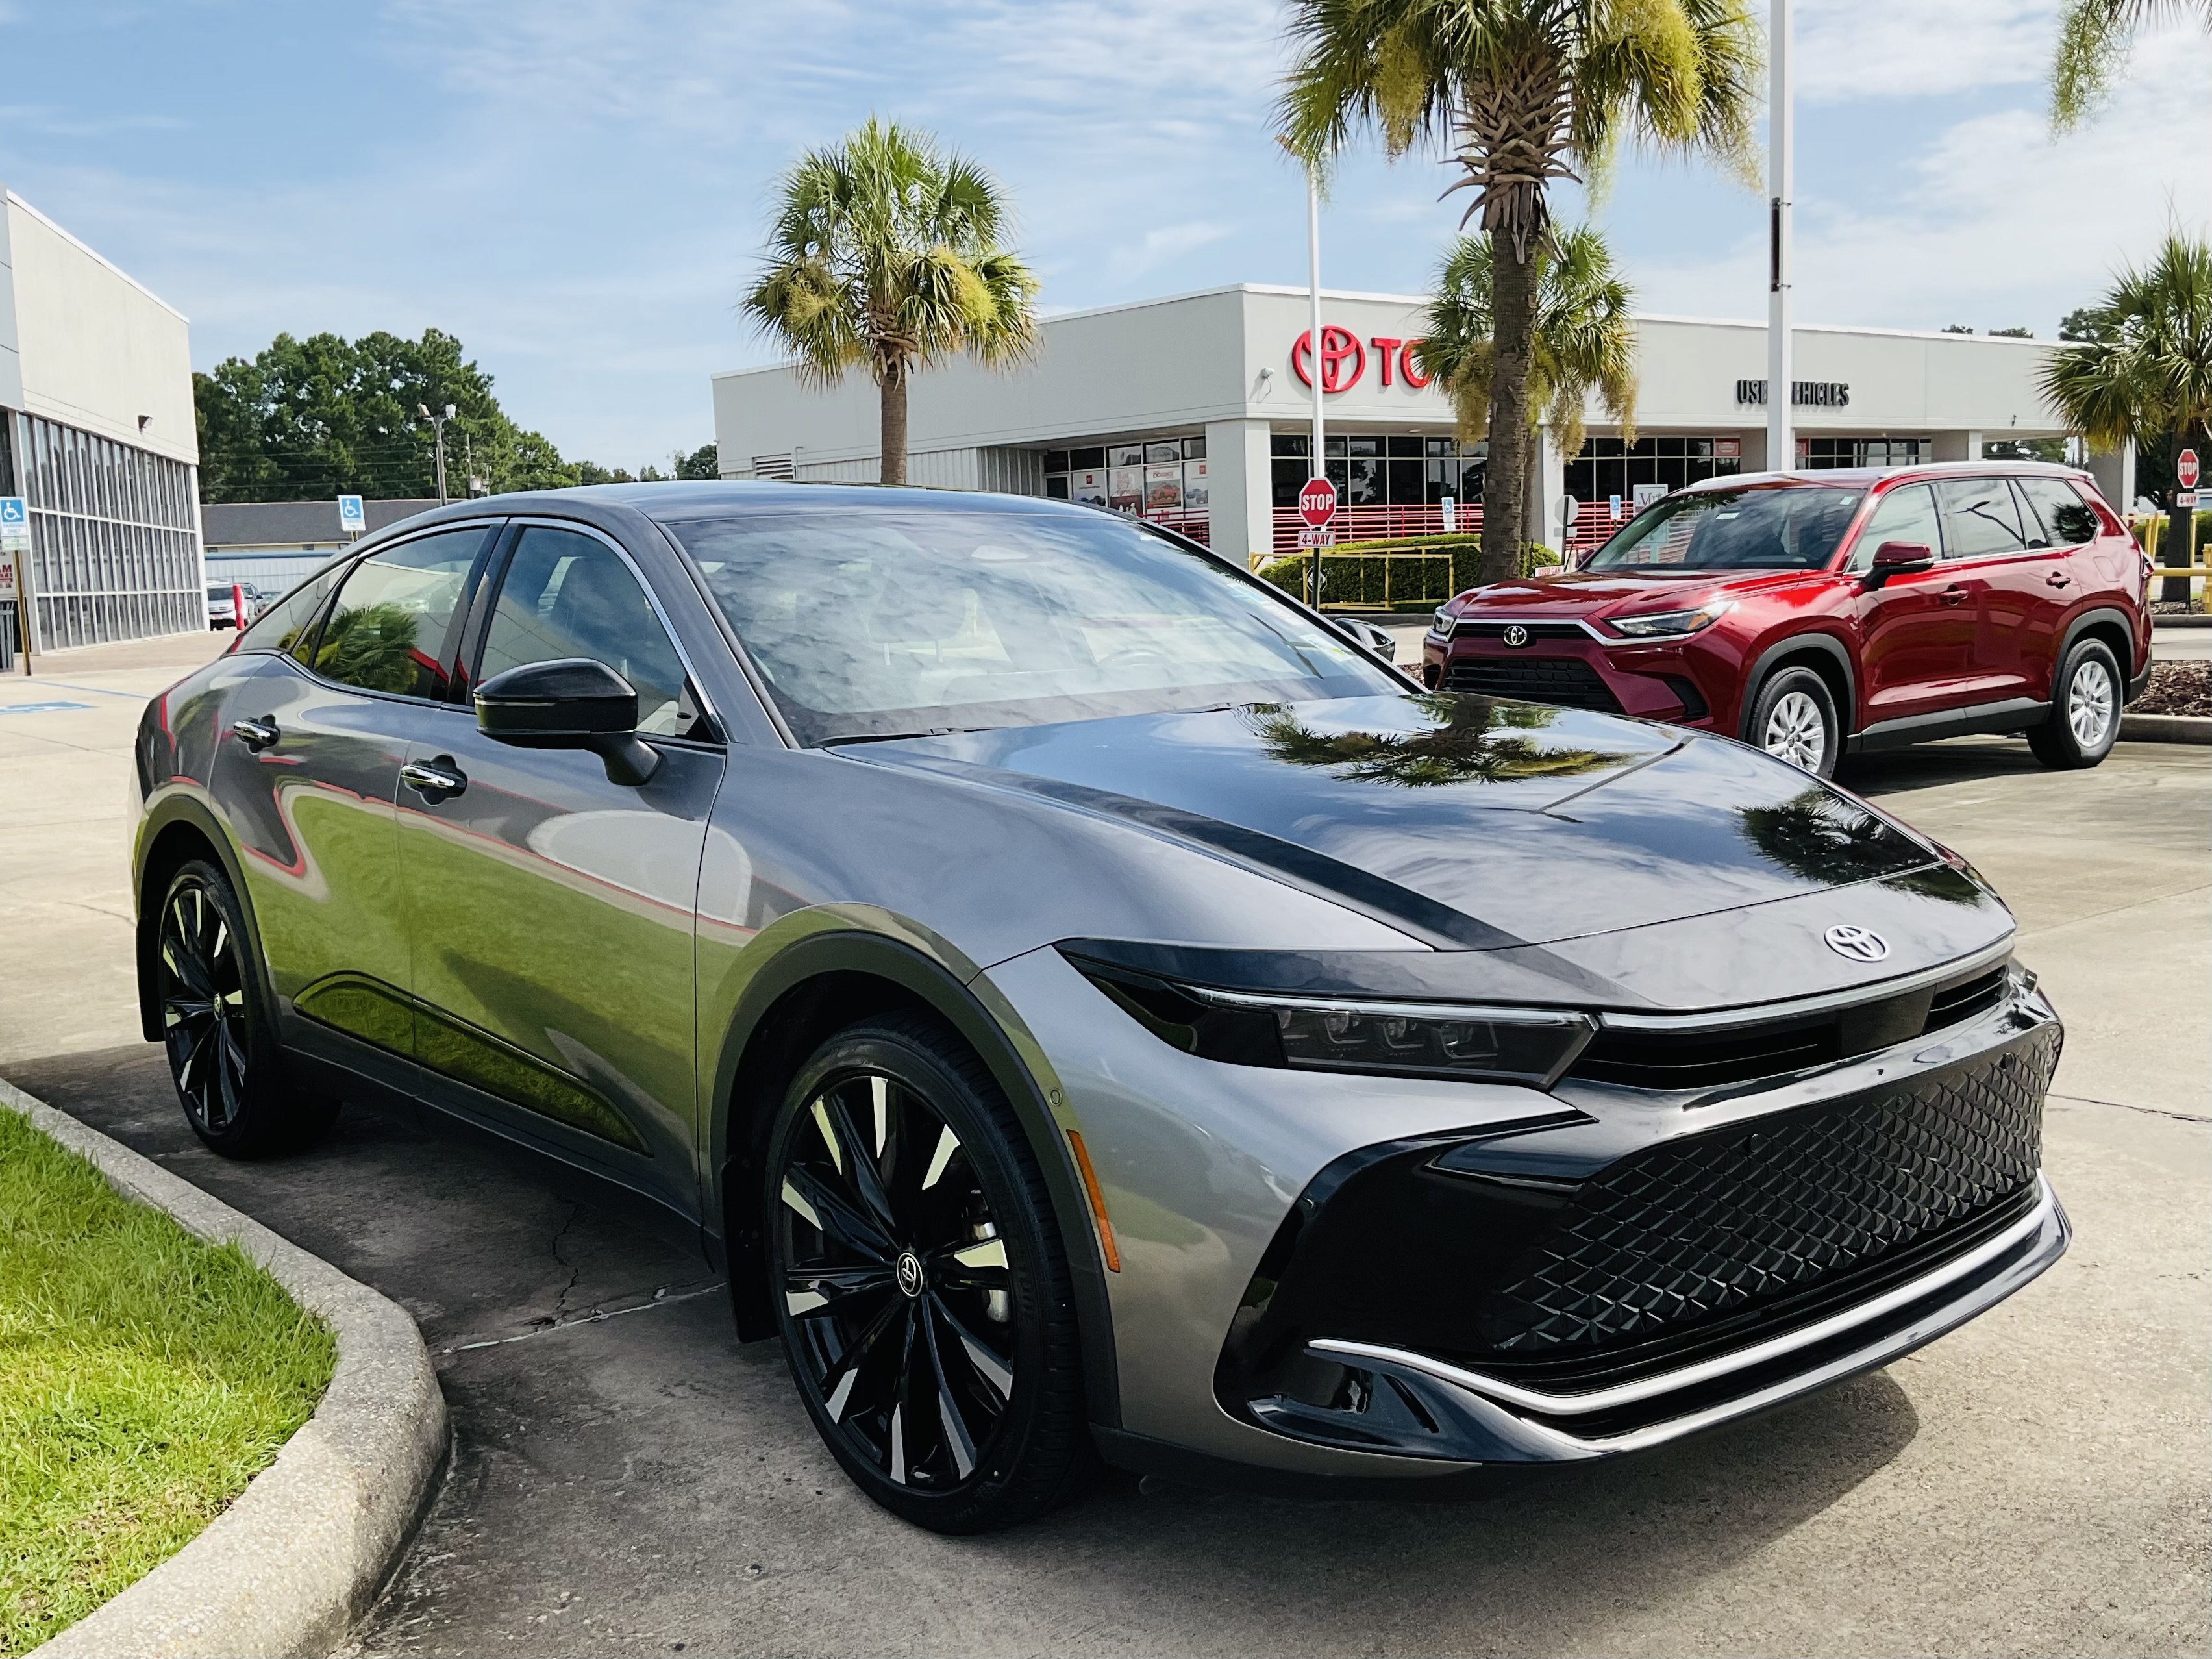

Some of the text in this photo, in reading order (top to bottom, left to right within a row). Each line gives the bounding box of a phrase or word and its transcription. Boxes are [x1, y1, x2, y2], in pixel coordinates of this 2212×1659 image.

[1737, 379, 1849, 406] USE EHICLES
[2179, 462, 2197, 475] STOP
[1302, 493, 1334, 511] STOP
[2180, 495, 2196, 505] 4-WAY
[1302, 534, 1330, 545] 4-WAY
